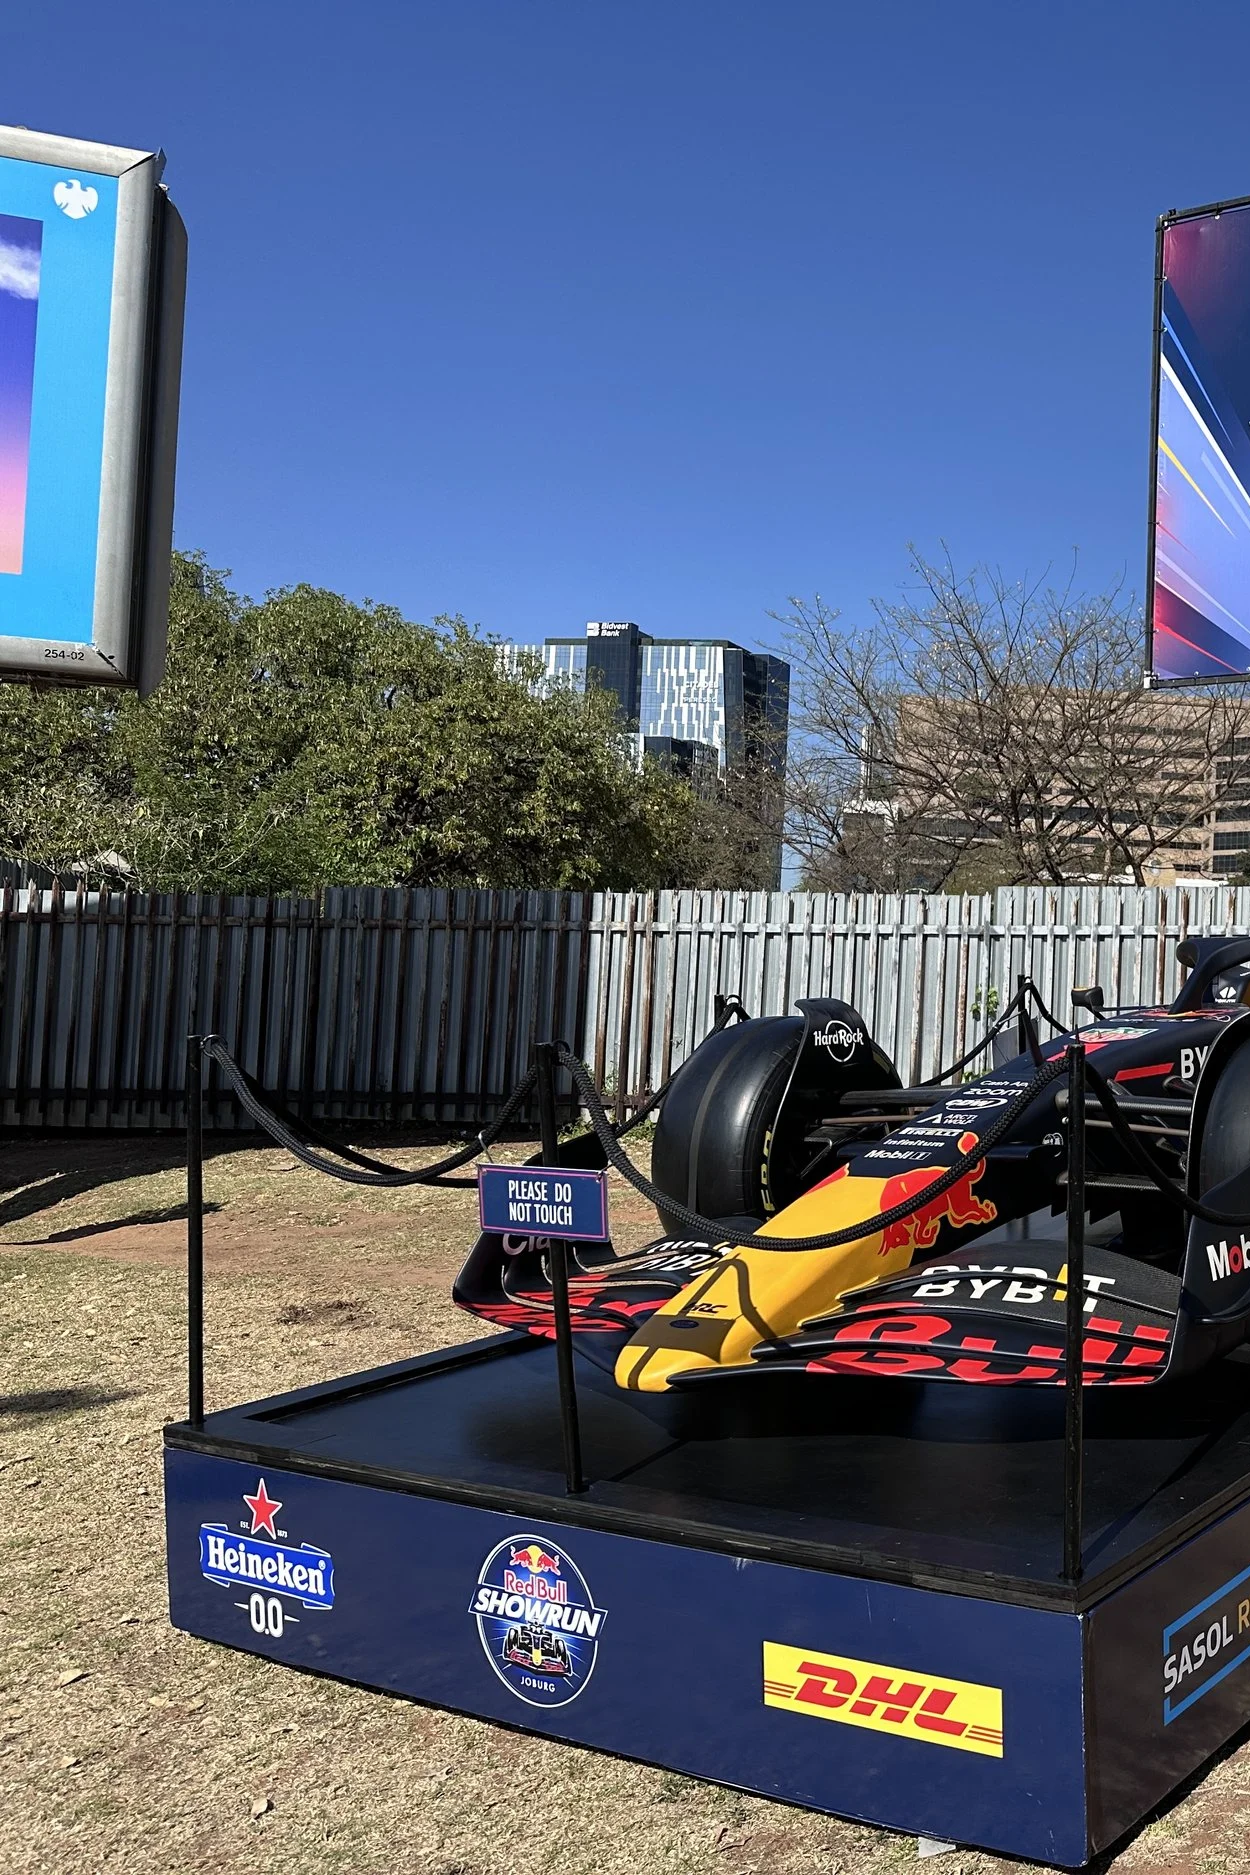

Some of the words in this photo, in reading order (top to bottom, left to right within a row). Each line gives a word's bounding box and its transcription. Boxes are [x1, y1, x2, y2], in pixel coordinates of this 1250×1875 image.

[600, 622, 629, 630] Bidvest
[600, 629, 620, 637] Bank
[44, 648, 85, 661] 254-02
[963, 1088, 1023, 1096] zoom
[864, 1149, 910, 1160] Mobil
[508, 1179, 548, 1202] PLEASE
[554, 1183, 572, 1203] DO
[508, 1202, 531, 1222] NOT
[533, 1205, 573, 1226] TOUCH
[911, 1263, 1116, 1313] BYBIT
[206, 1535, 326, 1596] Heineken
[504, 1569, 535, 1596] Red
[537, 1576, 568, 1606] Bull
[250, 1592, 284, 1638] 0.0
[474, 1587, 602, 1638] SHOWRUN
[1163, 1612, 1234, 1694] SASOL
[520, 1676, 556, 1693] JOBURG
[795, 1660, 970, 1737] DHL
